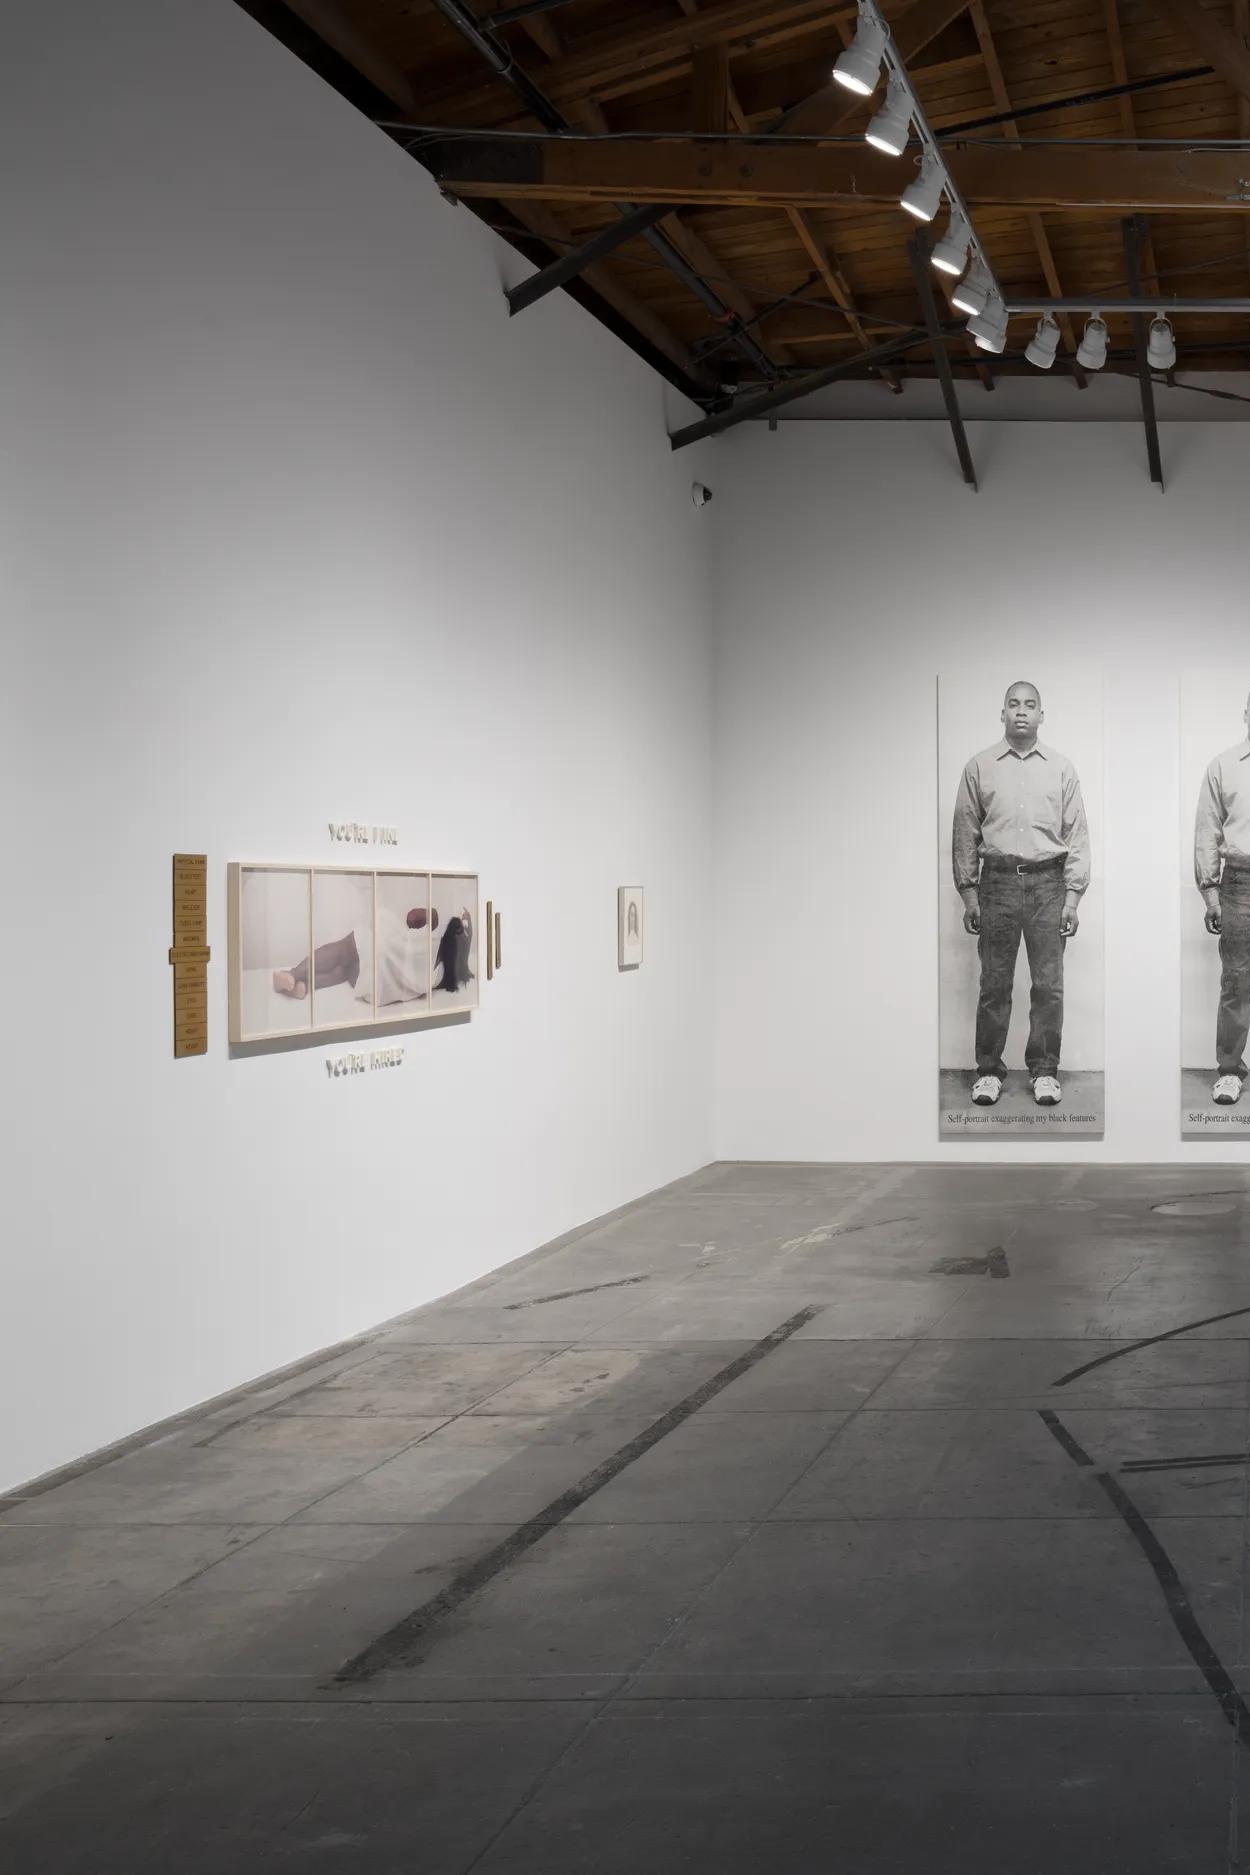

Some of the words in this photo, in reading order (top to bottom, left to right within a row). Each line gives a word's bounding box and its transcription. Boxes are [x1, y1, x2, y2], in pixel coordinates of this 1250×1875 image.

[948, 1114, 989, 1124] Self-portrait
[991, 1114, 1034, 1124] exaggerating
[1036, 1116, 1046, 1124] my
[1049, 1113, 1067, 1123] black
[1069, 1114, 1096, 1123] features
[1189, 1113, 1229, 1124] Self-portrait
